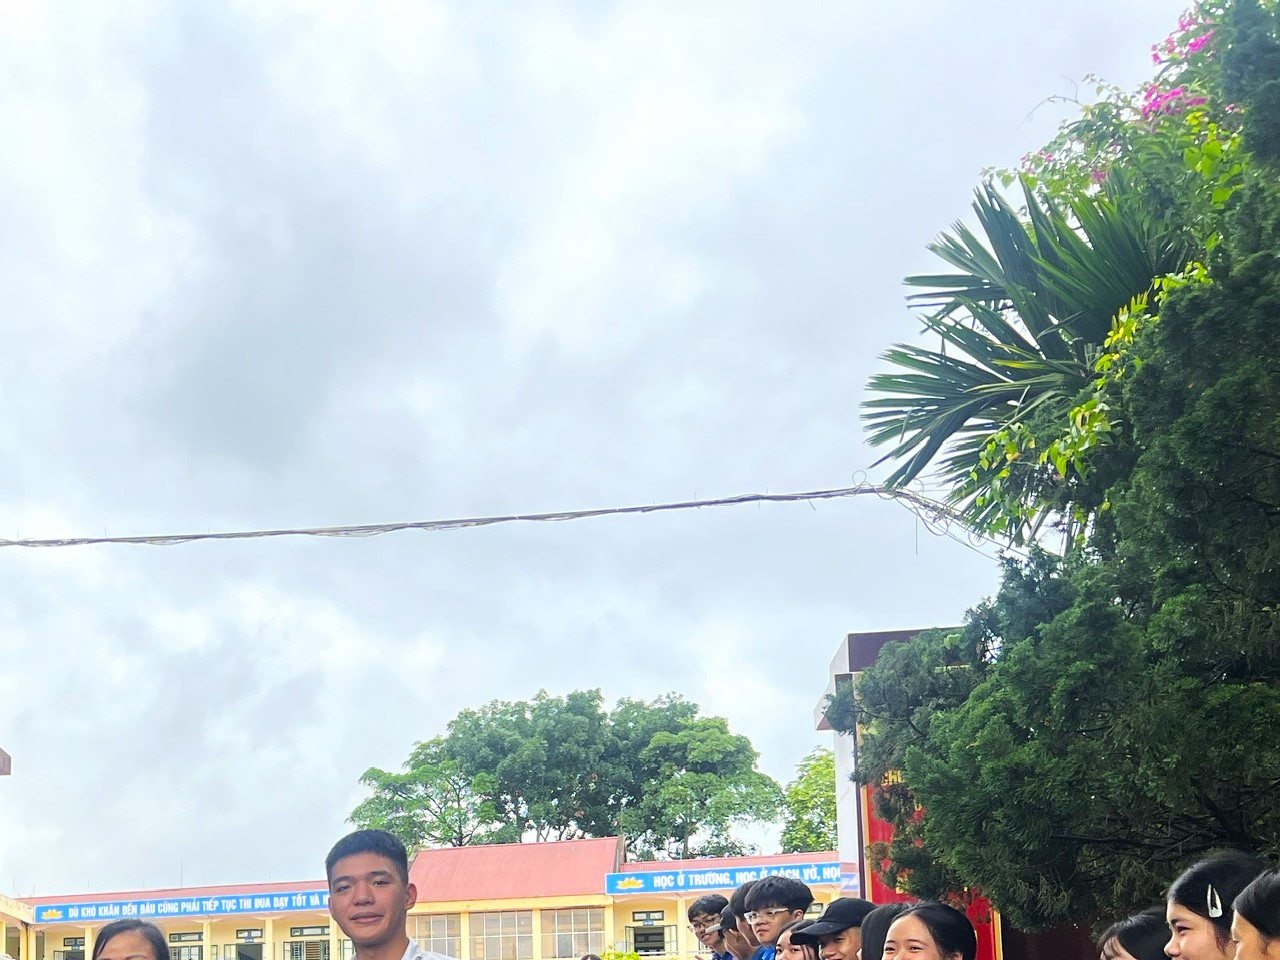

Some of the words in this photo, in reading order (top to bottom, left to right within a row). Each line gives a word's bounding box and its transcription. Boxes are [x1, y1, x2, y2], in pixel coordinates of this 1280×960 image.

[653, 875, 675, 890] HỌC
[677, 871, 686, 886] Ở
[688, 871, 734, 886] TRƯỜNG,
[802, 864, 821, 881] VỞ,
[81, 905, 96, 917] KHÓ
[99, 904, 119, 916] KHĂN
[122, 901, 137, 915] ĐẾN
[158, 901, 179, 913] CŨNG
[181, 898, 200, 912] PHẢI
[202, 897, 219, 911] TIẾP
[221, 899, 237, 912] TỤC
[239, 899, 251, 909] THI
[254, 897, 271, 909] ĐUA
[273, 896, 289, 910] DẠY
[291, 892, 307, 907] TỐT
[309, 892, 320, 906] VÀ
